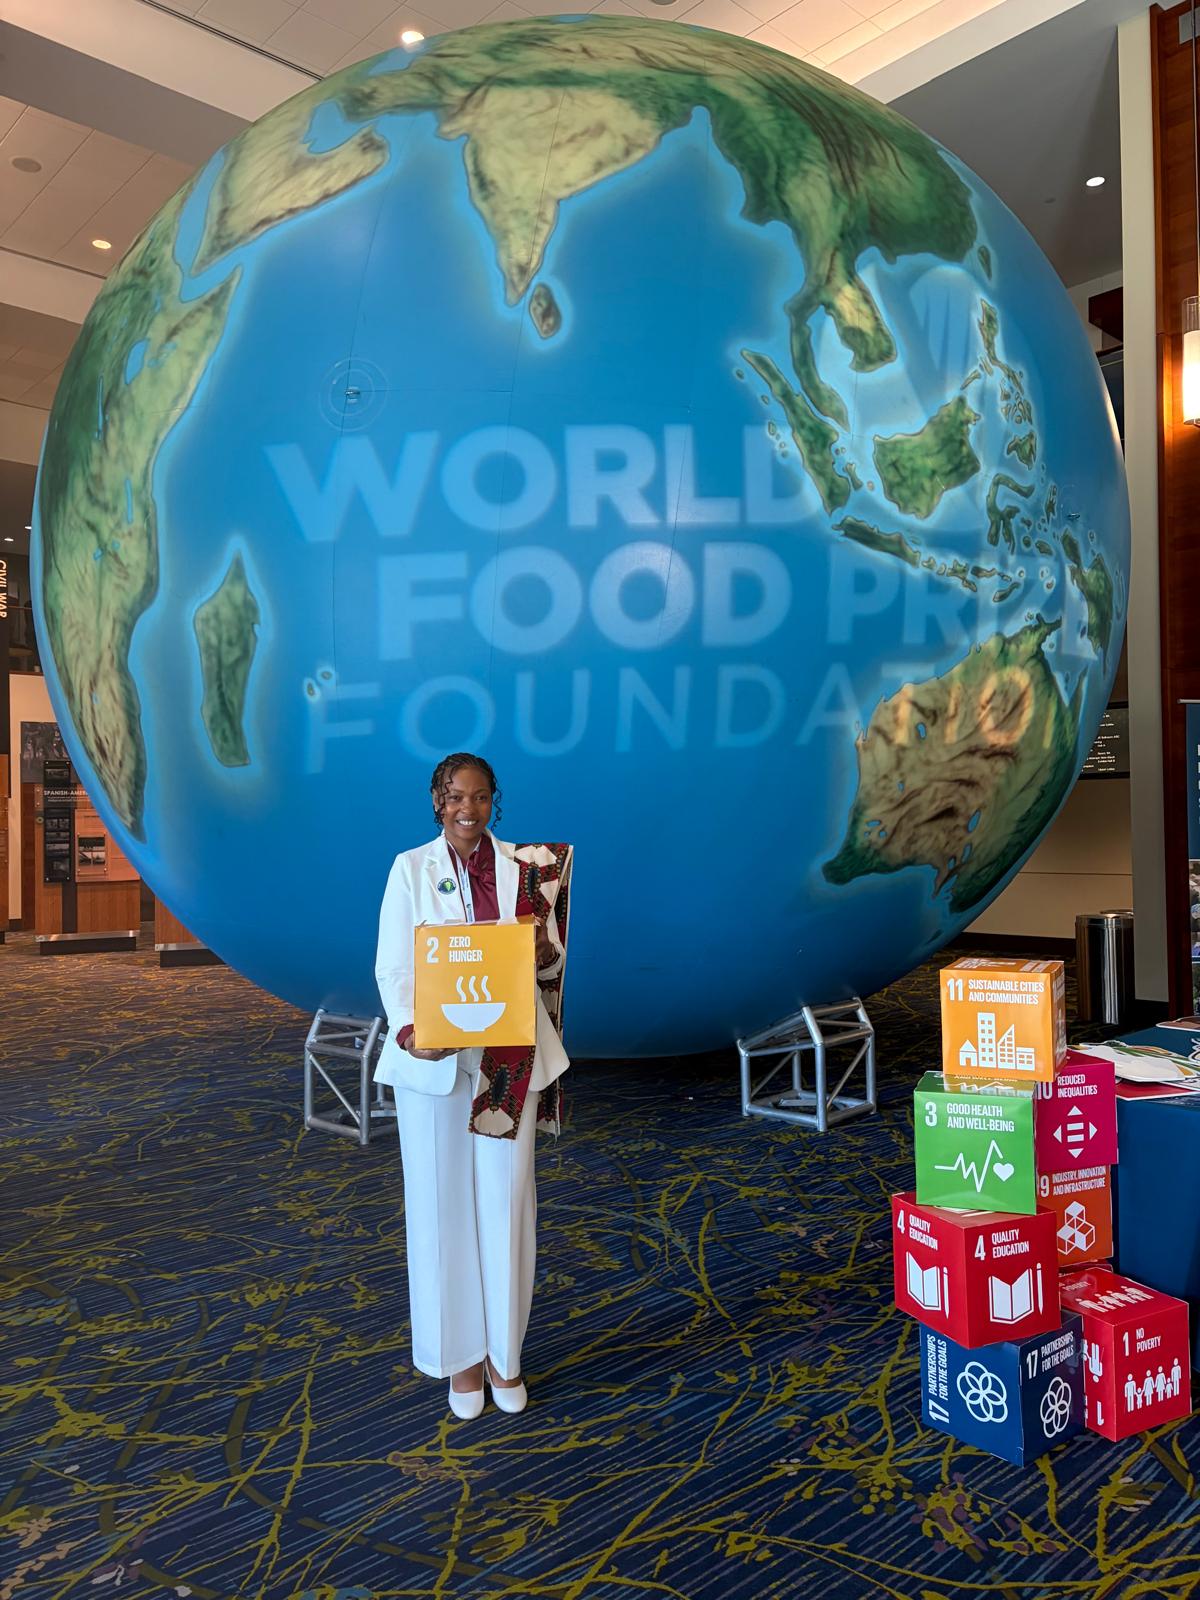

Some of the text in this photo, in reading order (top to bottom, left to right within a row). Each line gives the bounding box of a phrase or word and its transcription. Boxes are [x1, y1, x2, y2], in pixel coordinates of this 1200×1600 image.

[264, 423, 838, 543] WORLD
[377, 540, 1098, 662] FOOD PRIZE
[426, 936, 439, 963] 2
[449, 936, 471, 948] ZERO
[449, 950, 483, 963] HUNGER
[947, 978, 964, 1001] 11
[968, 979, 1019, 992] SUSTAINABLE
[1019, 981, 1045, 993] CITIES
[968, 991, 1039, 1005] AND COMMUNITIES
[1057, 1074, 1086, 1086] REDUCED
[1057, 1085, 1098, 1099] INEQUALITIES
[925, 1101, 938, 1127] 3
[947, 1103, 1003, 1117] GOOD HEALTH
[947, 1116, 1015, 1132] AND WELL-BEING
[1077, 1165, 1106, 1180] INNOVATION
[1040, 1175, 1050, 1198] 9
[1053, 1177, 1106, 1196] AND INFRASTRUCTURE
[897, 1209, 906, 1234] 4
[909, 1214, 931, 1234] QUALITY
[909, 1227, 938, 1251] EDUCATION
[974, 1235, 986, 1261] 4
[991, 1229, 1020, 1245] QUALITY
[992, 1241, 1030, 1259] EDUCATION
[1041, 1331, 1074, 1358] PARTNERSHIPS
[1123, 1332, 1130, 1357] 1
[1136, 1327, 1145, 1340] NO
[1136, 1336, 1162, 1353] POVERTY
[927, 1334, 938, 1396] PARTNERSHIPS
[937, 1339, 949, 1401] FOR THE GOALS
[1026, 1349, 1038, 1380] 17
[1041, 1345, 1074, 1373] FOR THE GOALS
[928, 1398, 950, 1424] 17
